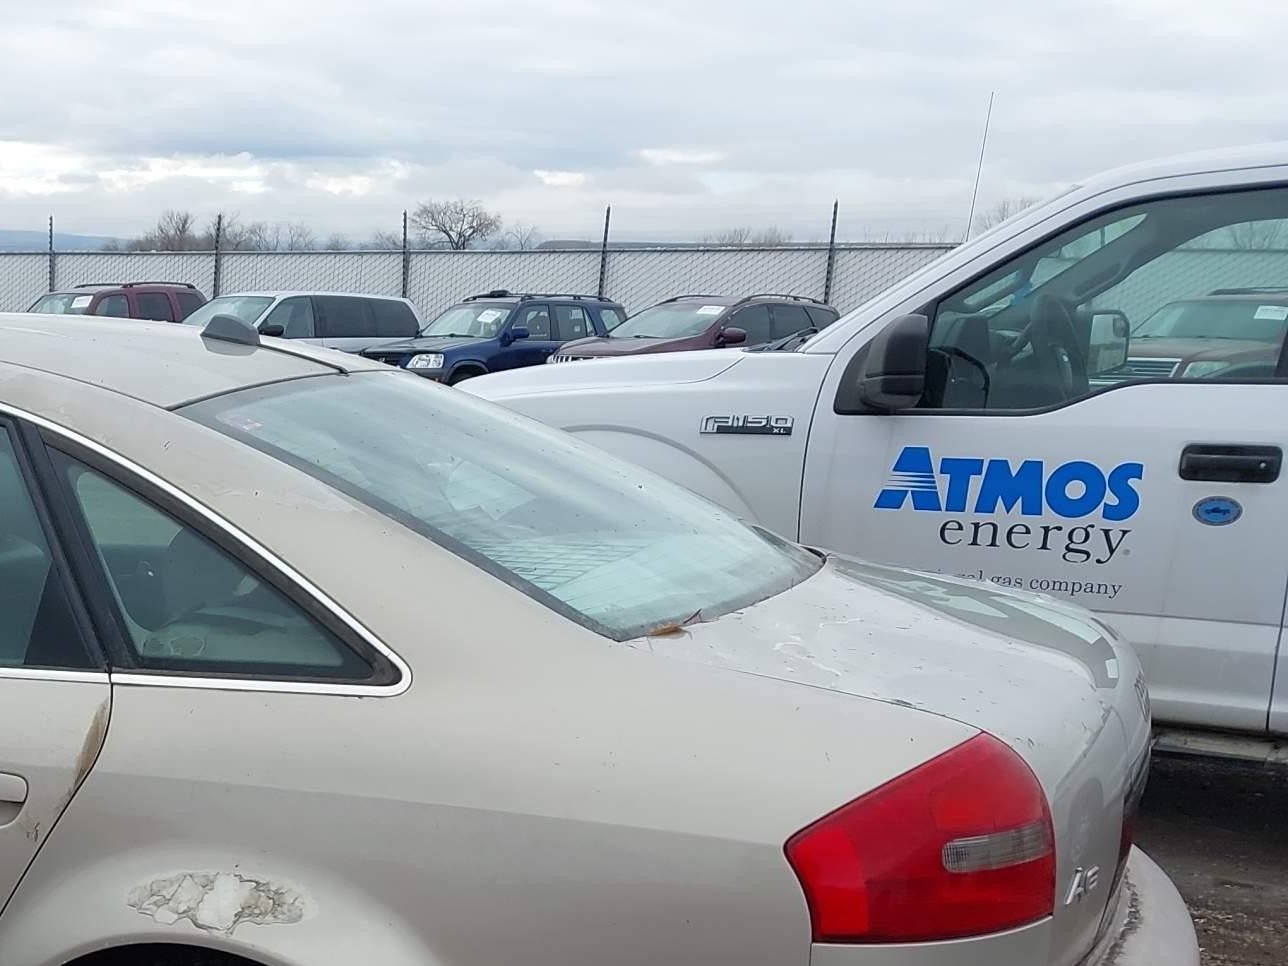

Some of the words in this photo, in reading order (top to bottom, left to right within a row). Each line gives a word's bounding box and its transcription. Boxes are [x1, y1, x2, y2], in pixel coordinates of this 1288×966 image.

[873, 446, 1144, 521] ATMOS
[939, 518, 1131, 564] energy
[1029, 578, 1123, 599] company
